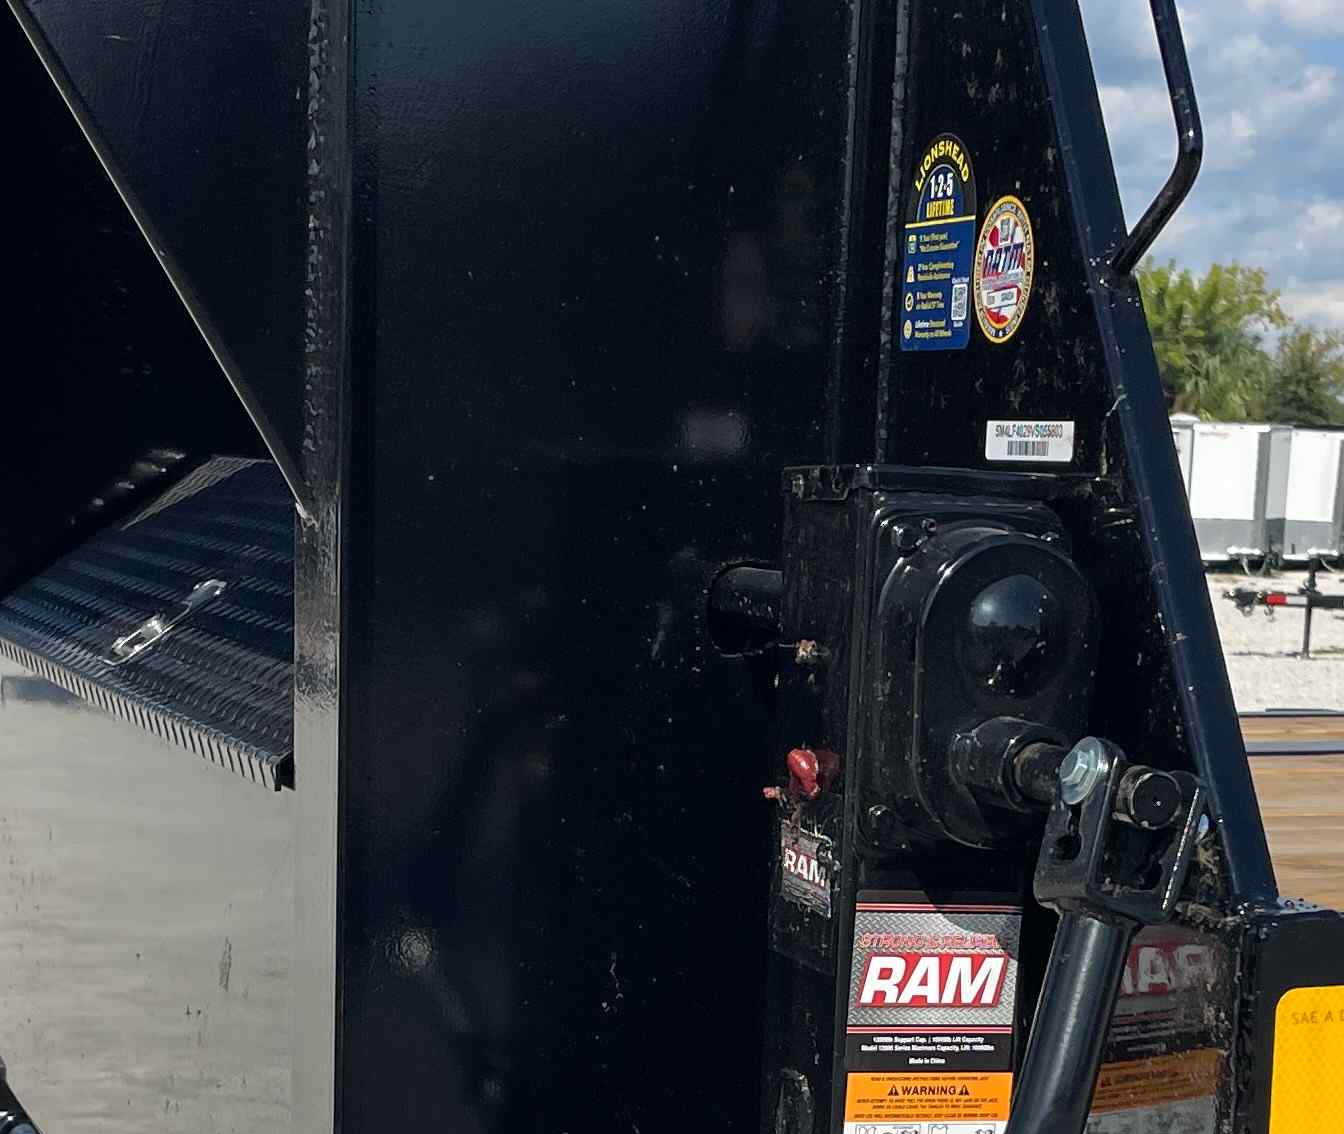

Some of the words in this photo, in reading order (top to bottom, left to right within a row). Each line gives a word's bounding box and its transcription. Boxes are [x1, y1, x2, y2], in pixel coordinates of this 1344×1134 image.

[915, 140, 969, 192] LIONSHEAD
[784, 847, 826, 887] RAM
[859, 956, 1005, 1004] RAM
[1291, 1011, 1319, 1026] SAE
[1324, 1009, 1334, 1023] A
[901, 1086, 956, 1096] WARNING
